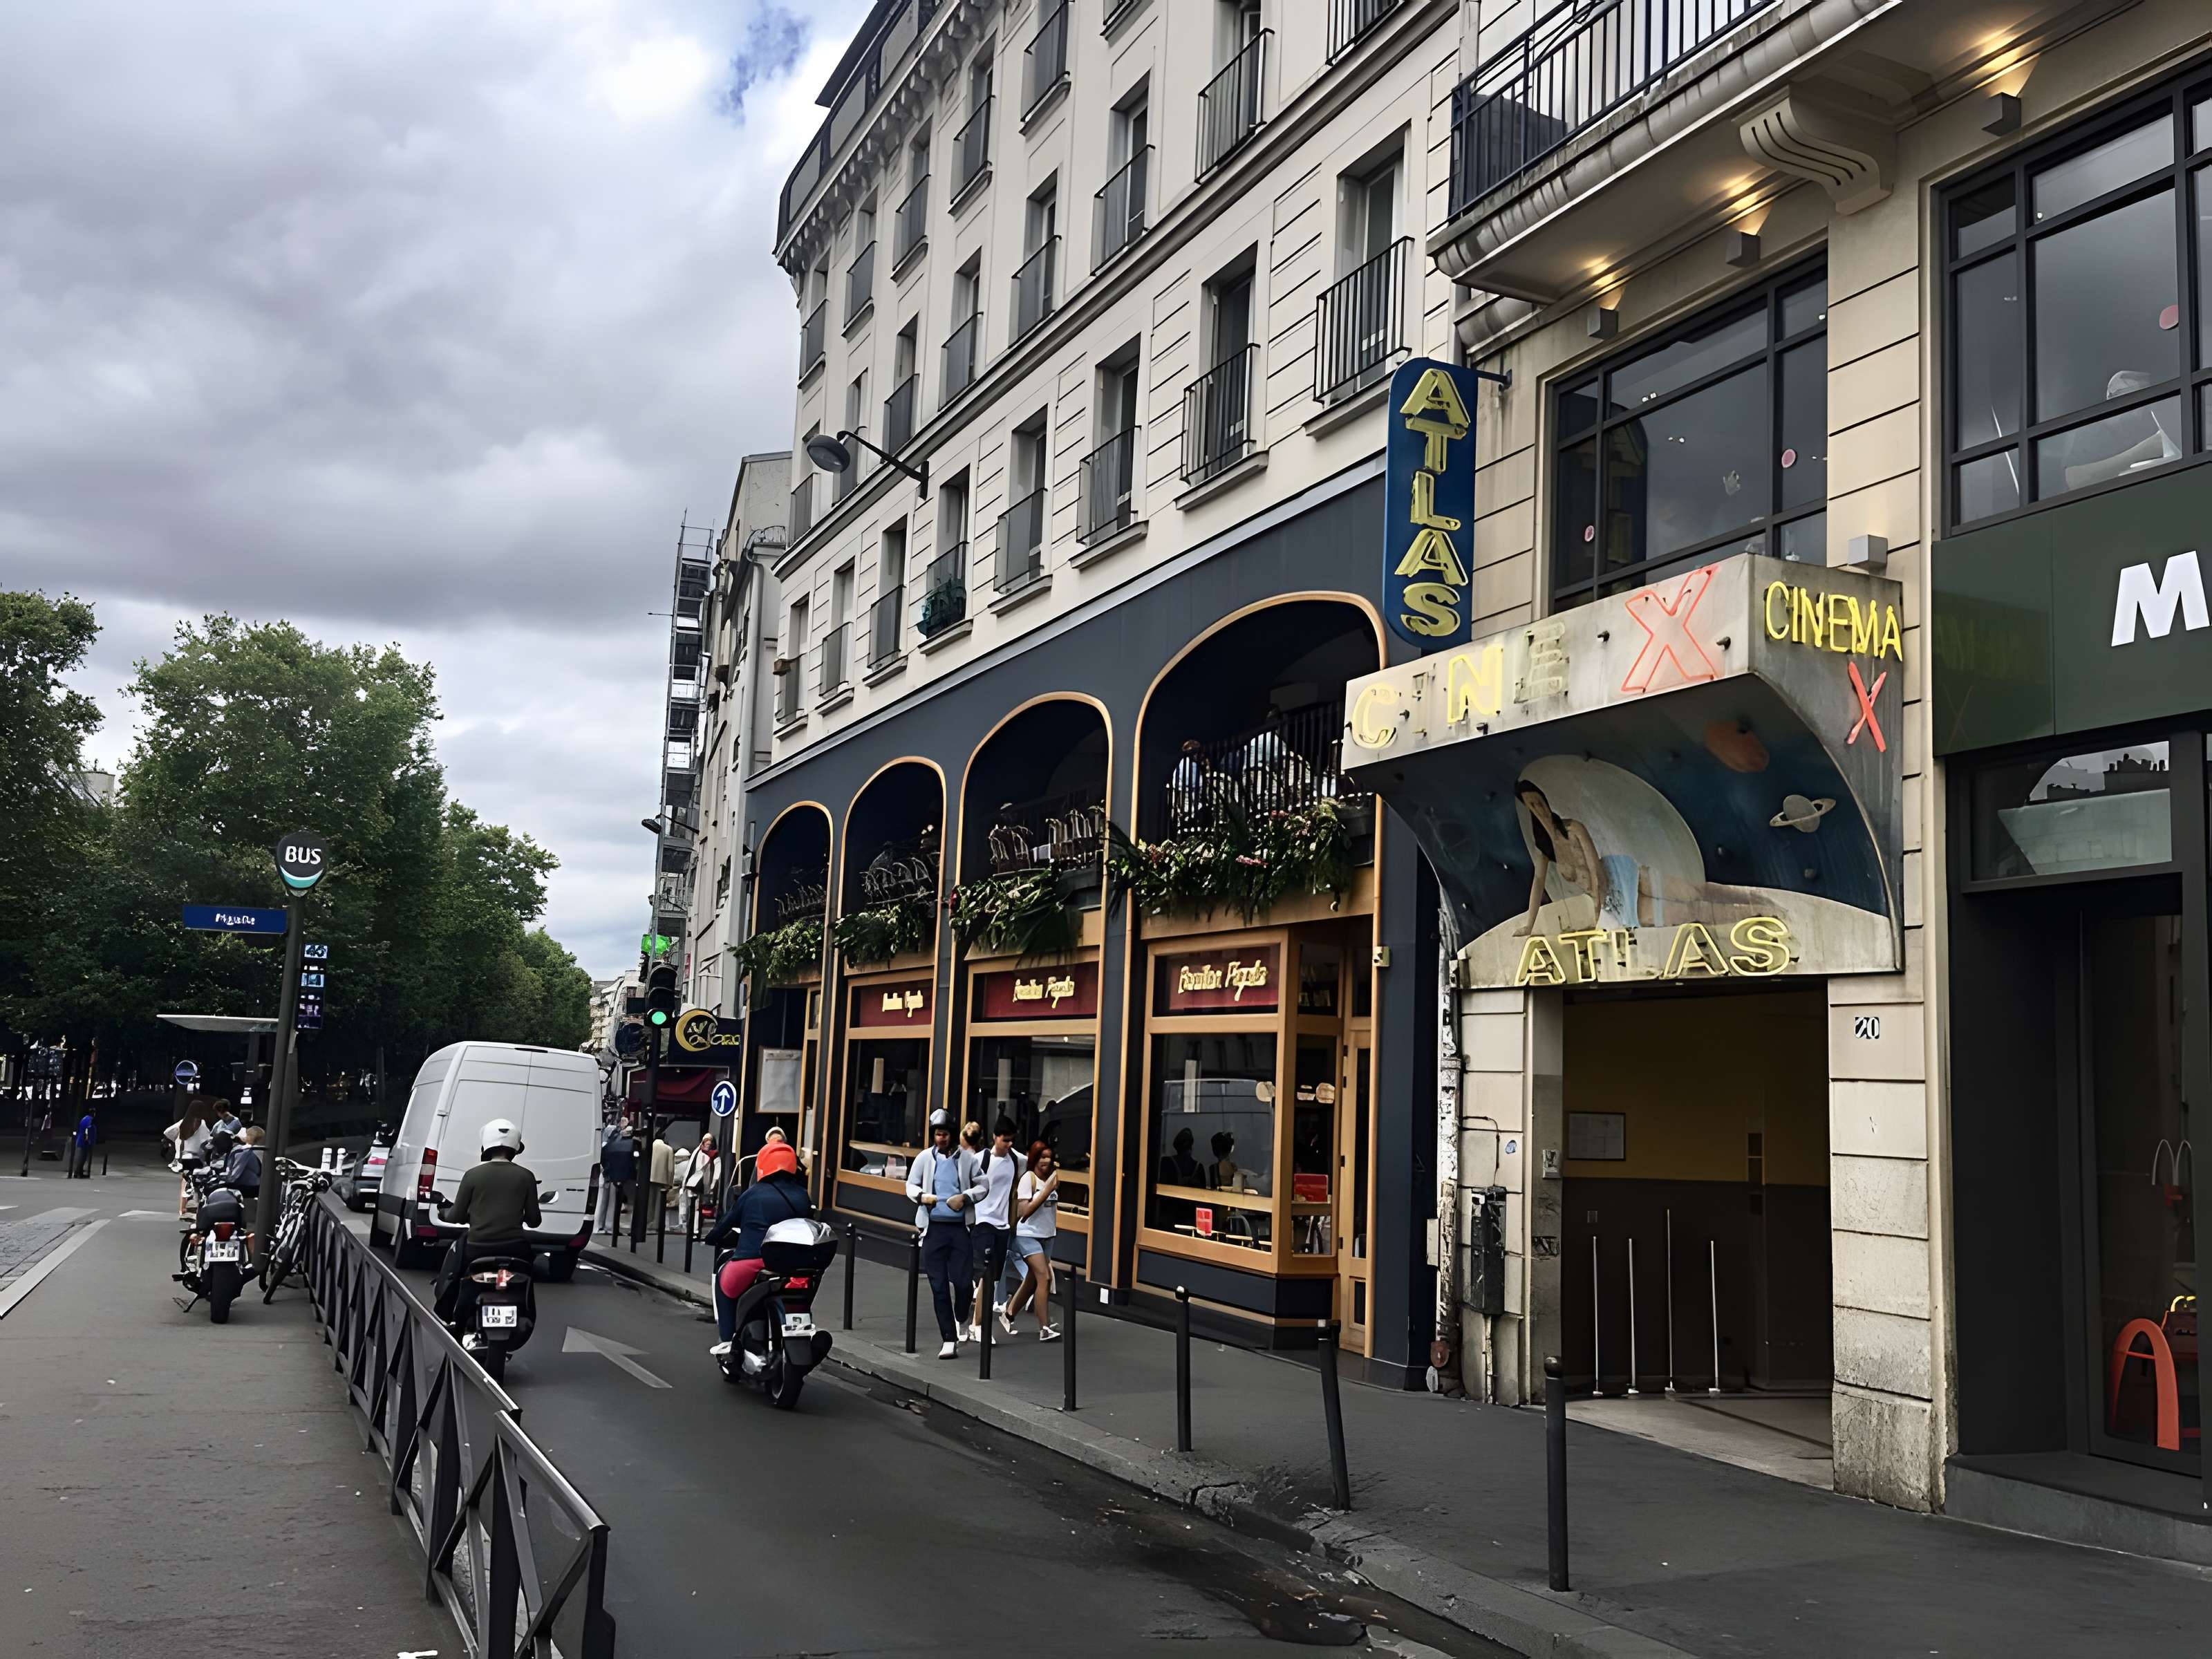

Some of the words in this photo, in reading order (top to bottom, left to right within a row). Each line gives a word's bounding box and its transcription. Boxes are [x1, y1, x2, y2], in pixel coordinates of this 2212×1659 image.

[1394, 368, 1470, 637] ATLAS
[1620, 564, 1720, 693] X
[1765, 581, 1903, 662] CINEMA
[1846, 661, 1887, 752] X
[285, 845, 321, 864] BUS
[1514, 917, 1791, 986] ATLAS
[1855, 1017, 1880, 1039] 20
